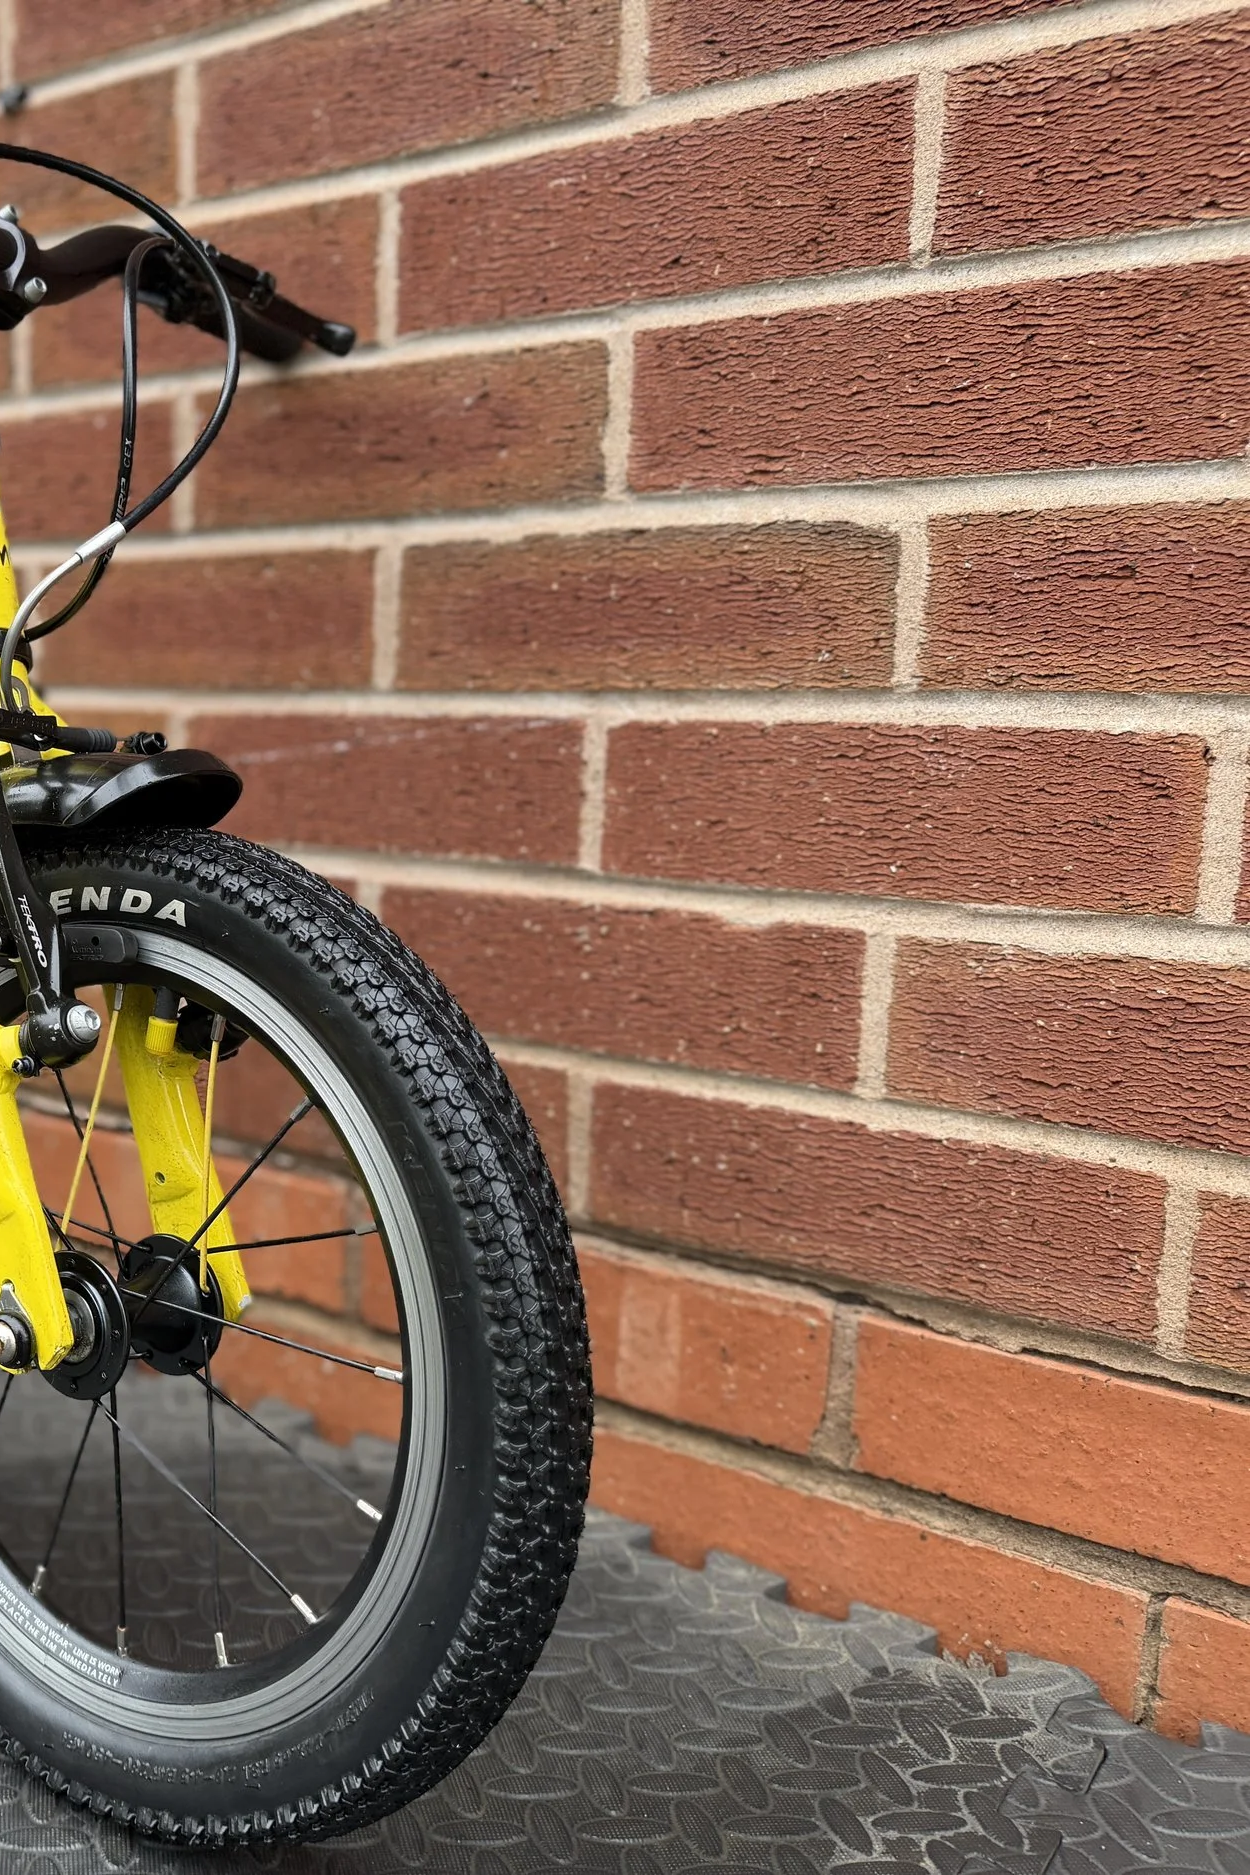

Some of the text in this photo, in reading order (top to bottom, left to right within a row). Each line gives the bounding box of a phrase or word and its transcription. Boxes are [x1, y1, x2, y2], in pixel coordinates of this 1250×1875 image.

[123, 437, 132, 468] CEX
[17, 894, 48, 969] TEKTRO
[49, 886, 187, 928] ENDA
[17, 1601, 32, 1618] THE
[72, 1646, 90, 1661] LINE
[89, 1655, 98, 1666] IS
[97, 1660, 121, 1676] WORN
[24, 1620, 40, 1639] THE
[39, 1634, 57, 1653] RIM
[58, 1649, 119, 1688] IMMEDIATELY
